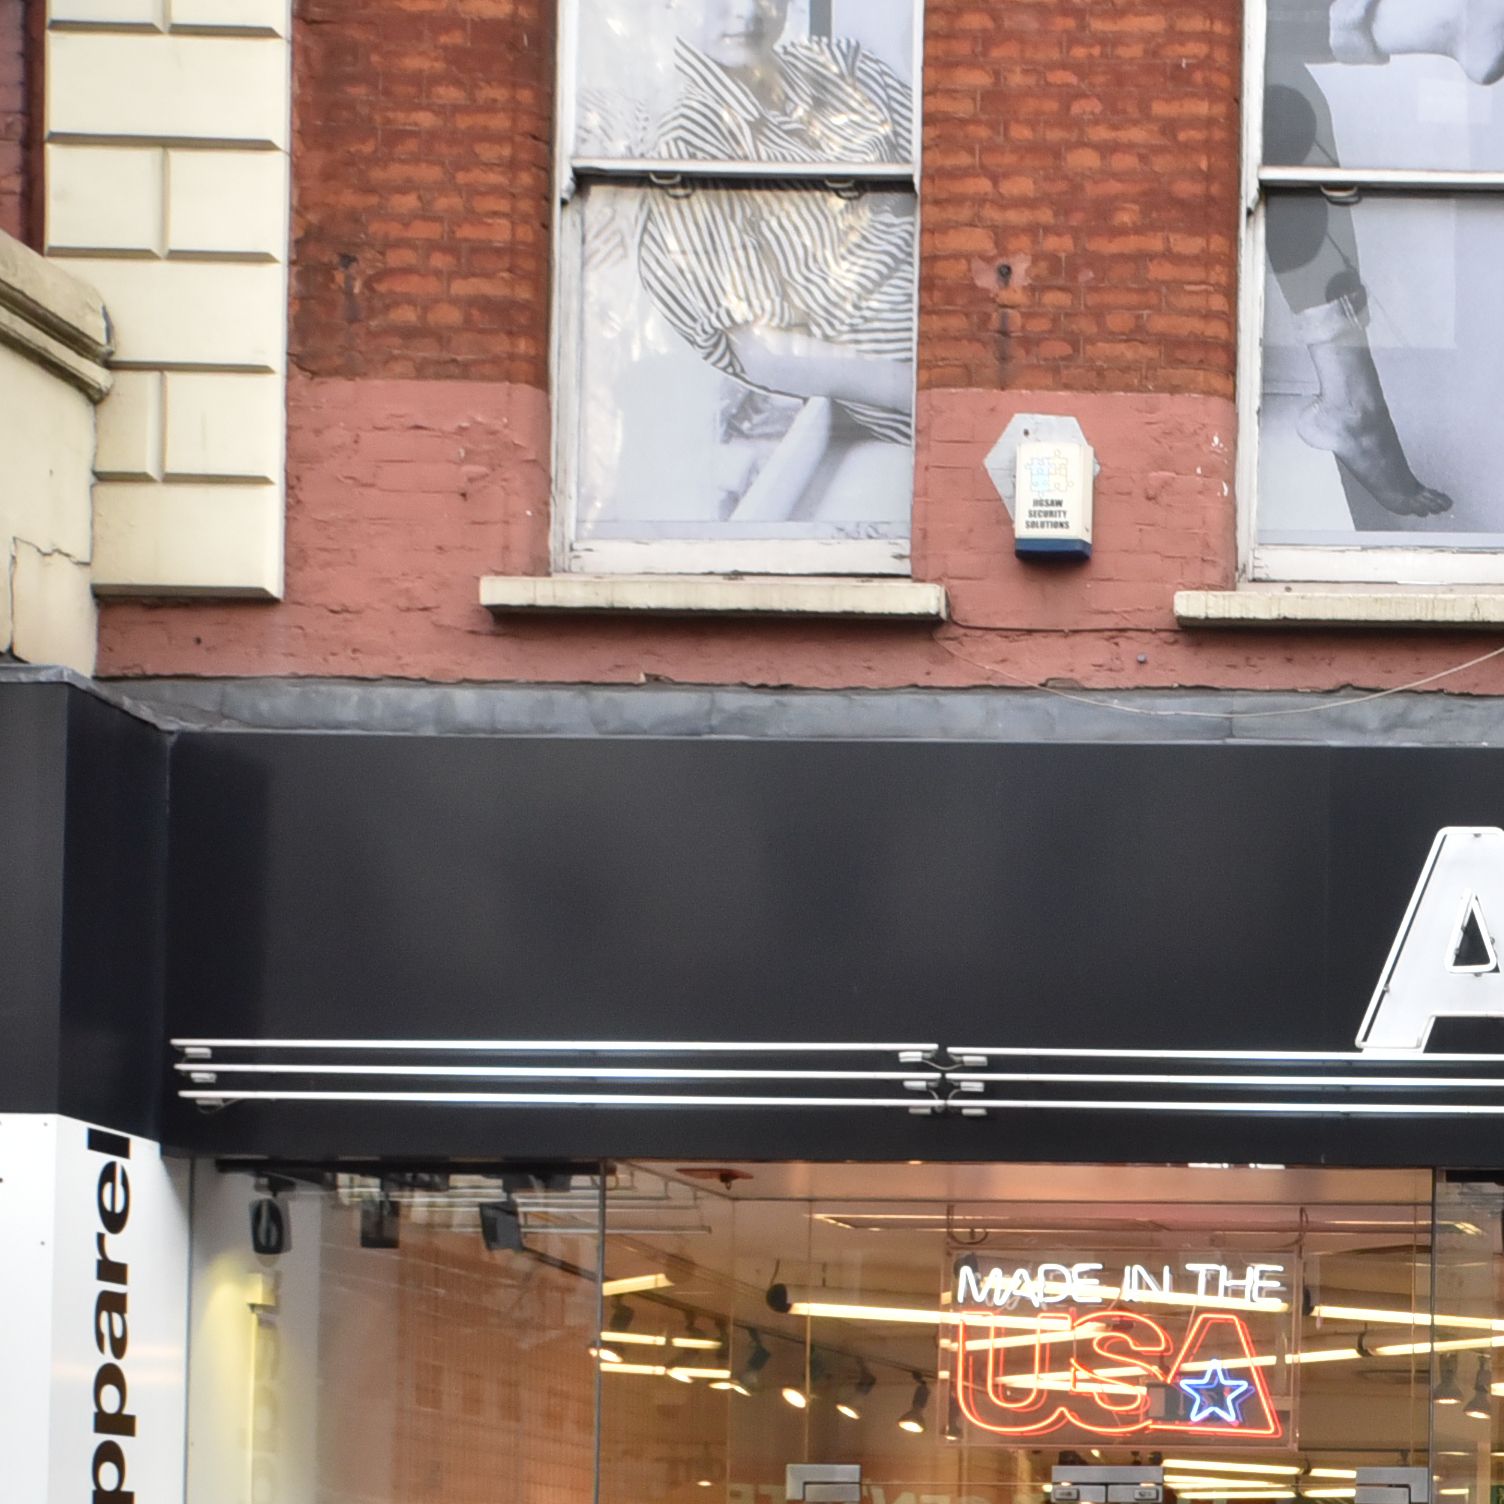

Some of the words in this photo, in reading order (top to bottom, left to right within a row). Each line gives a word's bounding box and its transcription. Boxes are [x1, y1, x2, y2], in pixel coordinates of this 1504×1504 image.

[1033, 499, 1063, 507] JIGSAW
[1028, 510, 1067, 518] SECURITY
[1025, 521, 1070, 529] SOLUTIONS
[957, 1263, 1103, 1307] MADE
[1124, 1265, 1170, 1301] IN
[1185, 1263, 1285, 1304] THE
[956, 1310, 1282, 1437] USA
